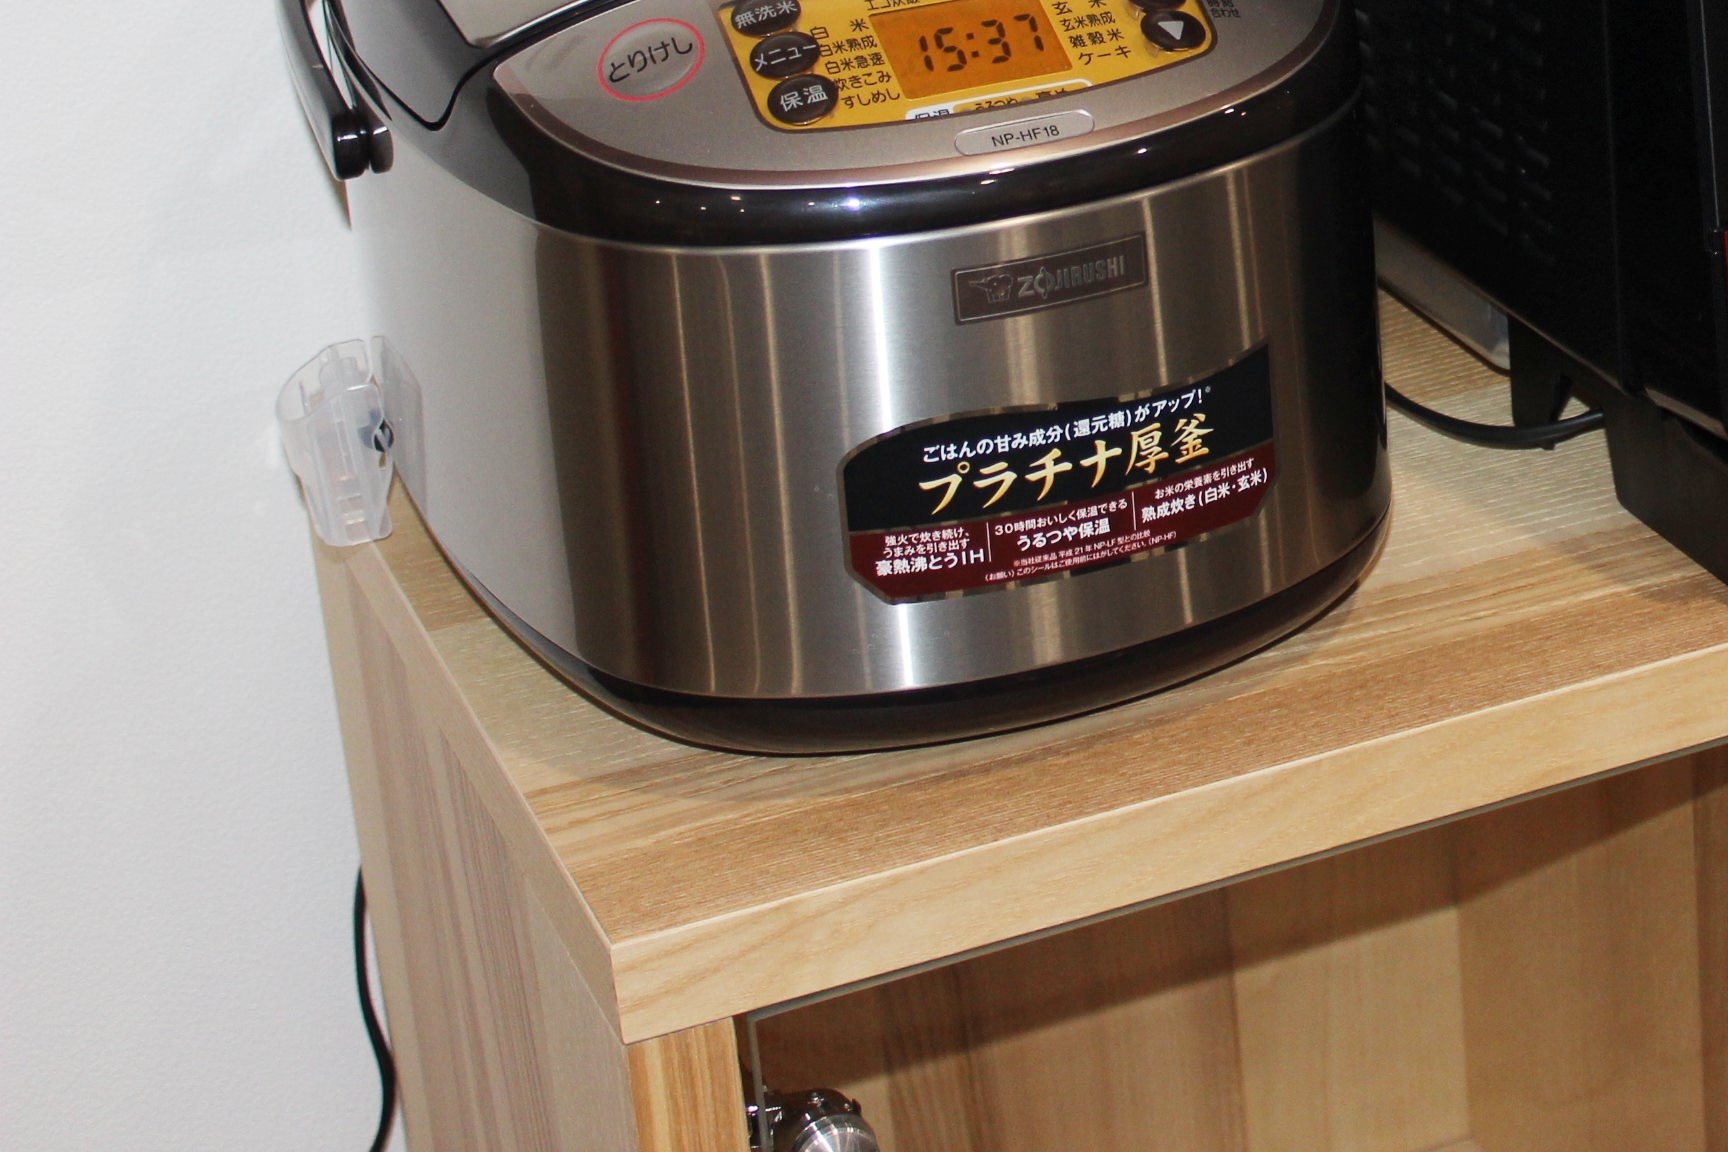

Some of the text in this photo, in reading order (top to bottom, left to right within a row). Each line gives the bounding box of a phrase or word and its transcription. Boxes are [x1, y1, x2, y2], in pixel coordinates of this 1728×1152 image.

[735, 0, 798, 29] 無洗米
[1060, 11, 1116, 32] 玄米熟成
[820, 35, 878, 57] 白米熟成
[918, 12, 1048, 74] 15:37
[1069, 29, 1125, 49] 雑穀米
[607, 35, 694, 85] とりけし
[755, 44, 817, 72] メニュー
[825, 52, 887, 75] 白米急速
[1078, 45, 1132, 66] ケーキ
[833, 70, 892, 92] 炊きこみ
[780, 84, 828, 112] 保温
[840, 88, 900, 109] すしめし
[992, 125, 1060, 147] NP-HF18
[1017, 255, 1125, 299] ZOJIRUSHI
[918, 413, 1215, 516] プラチナ厚釜
[1154, 458, 1254, 499] お米の栄養素を引き出す
[994, 498, 1128, 536] 30時間おいしく保温できる
[883, 538, 970, 558] うまみを引き出す
[1017, 518, 1111, 552] うるつや保温
